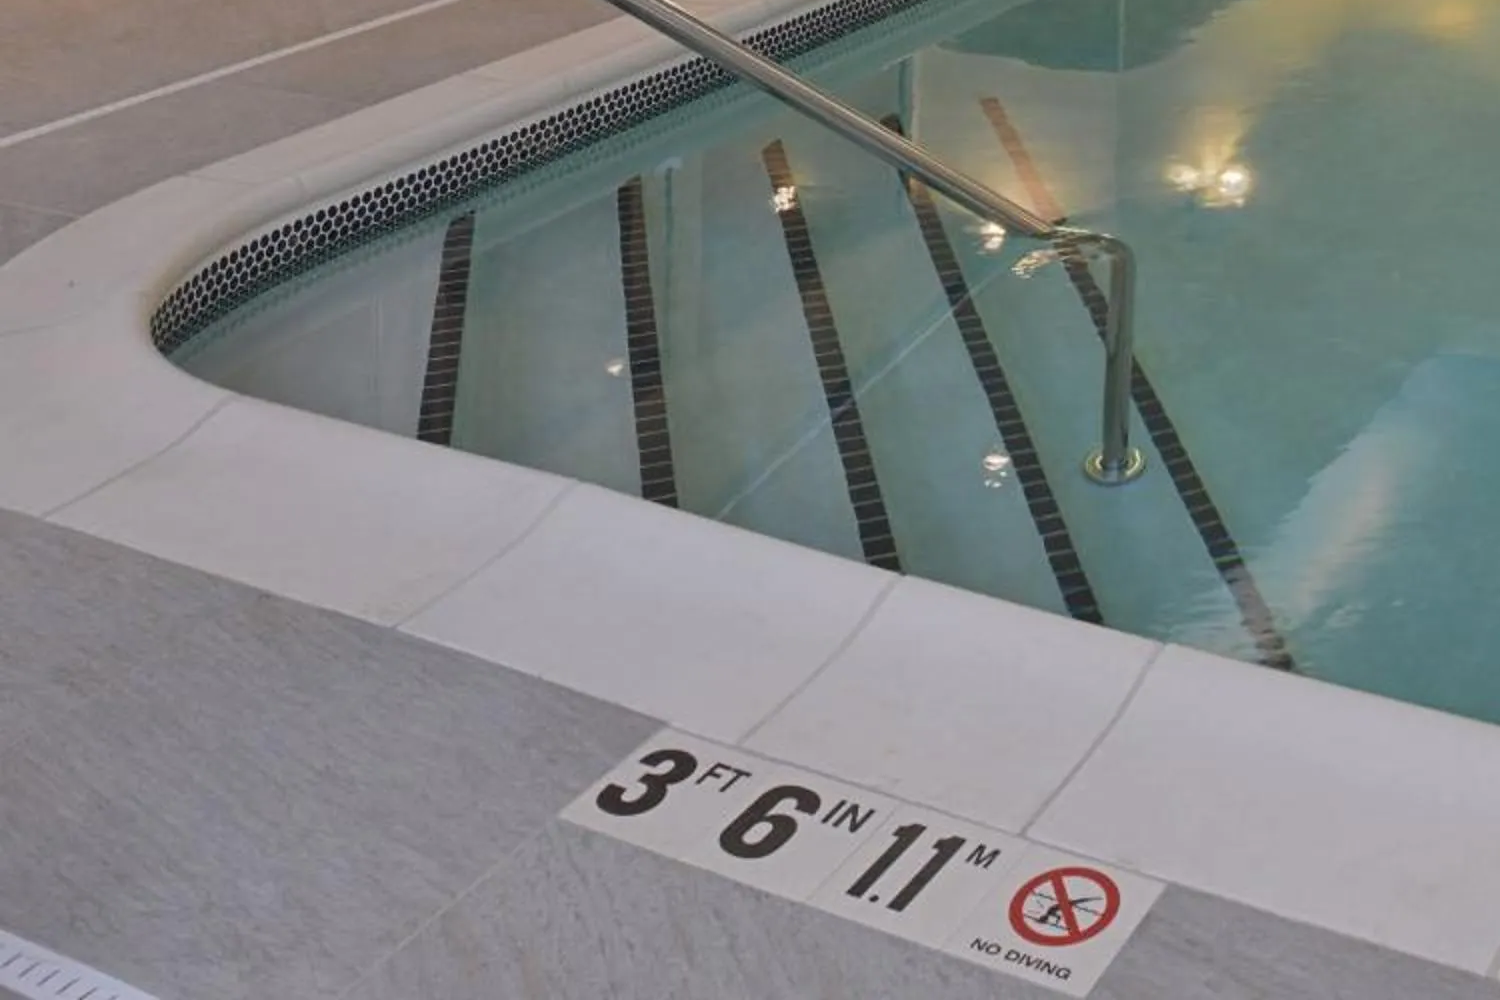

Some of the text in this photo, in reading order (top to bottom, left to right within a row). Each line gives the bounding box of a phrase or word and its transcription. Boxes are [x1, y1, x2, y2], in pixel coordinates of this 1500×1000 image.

[596, 749, 1001, 912] 3 FT 6 IN 1.1 M
[970, 938, 1072, 980] NO DIVING
